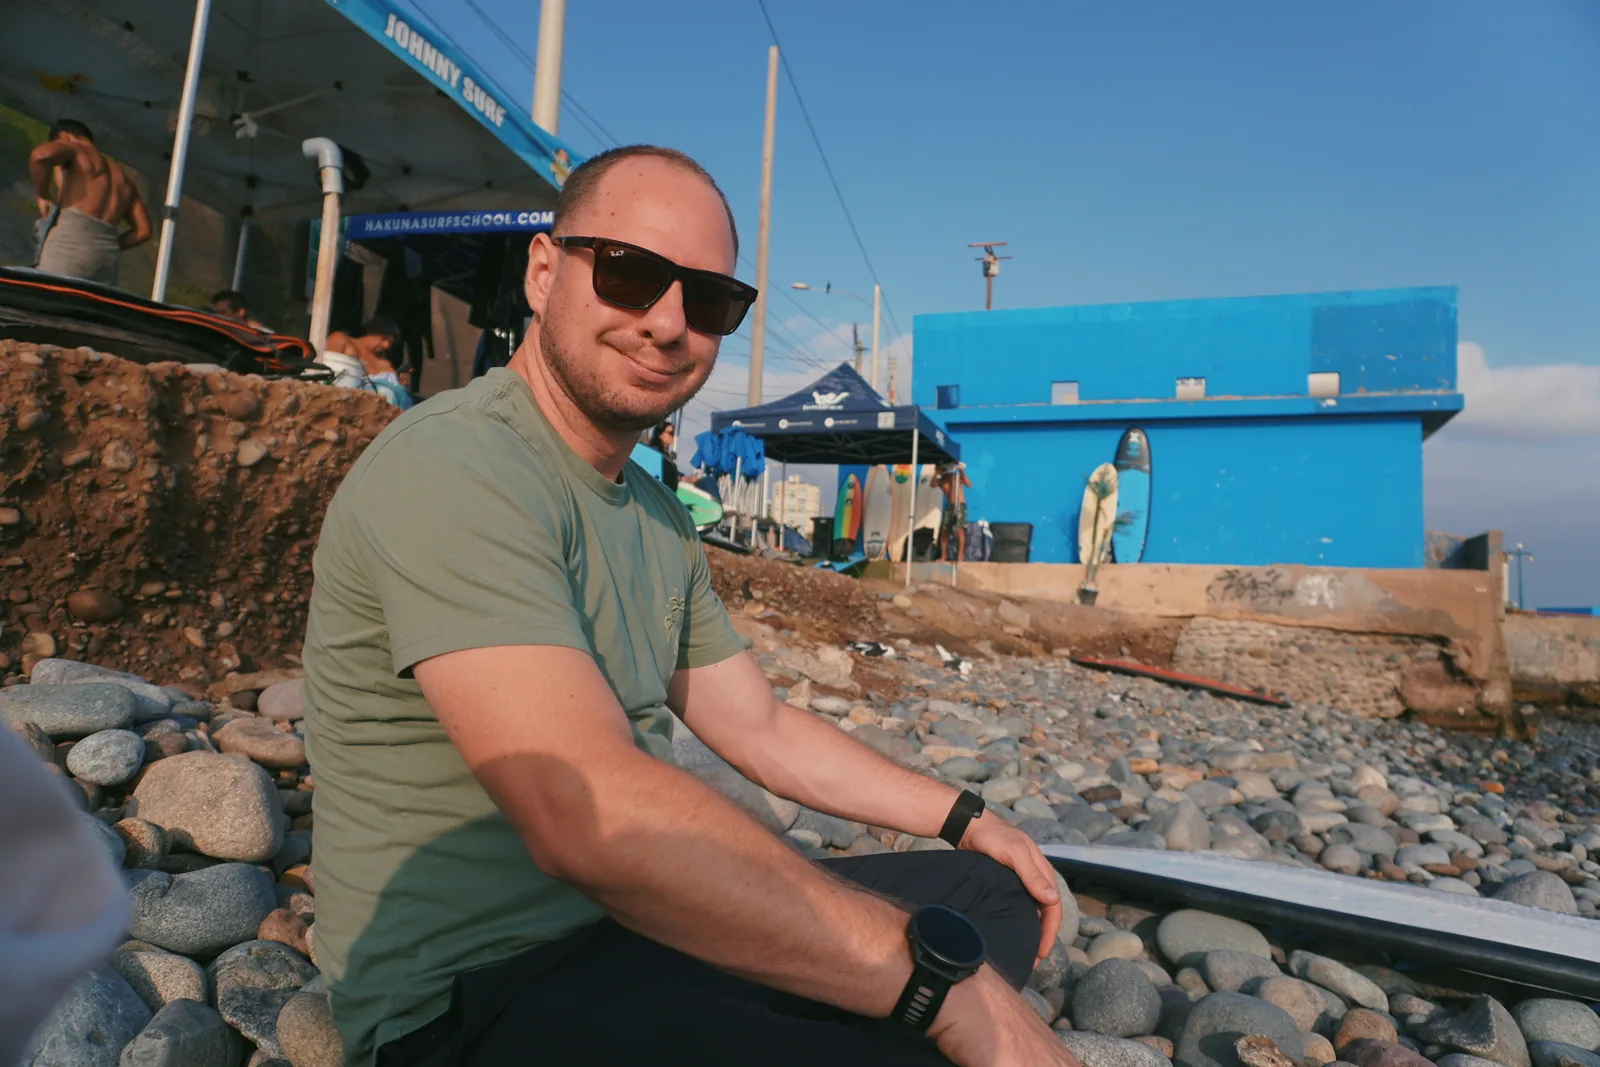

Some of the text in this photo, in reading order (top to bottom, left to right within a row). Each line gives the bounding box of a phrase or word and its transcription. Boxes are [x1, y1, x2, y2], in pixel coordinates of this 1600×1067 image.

[384, 13, 506, 127] JOHNNY SURF
[365, 211, 554, 231] HAKUNASURFSCHOOL.COM
